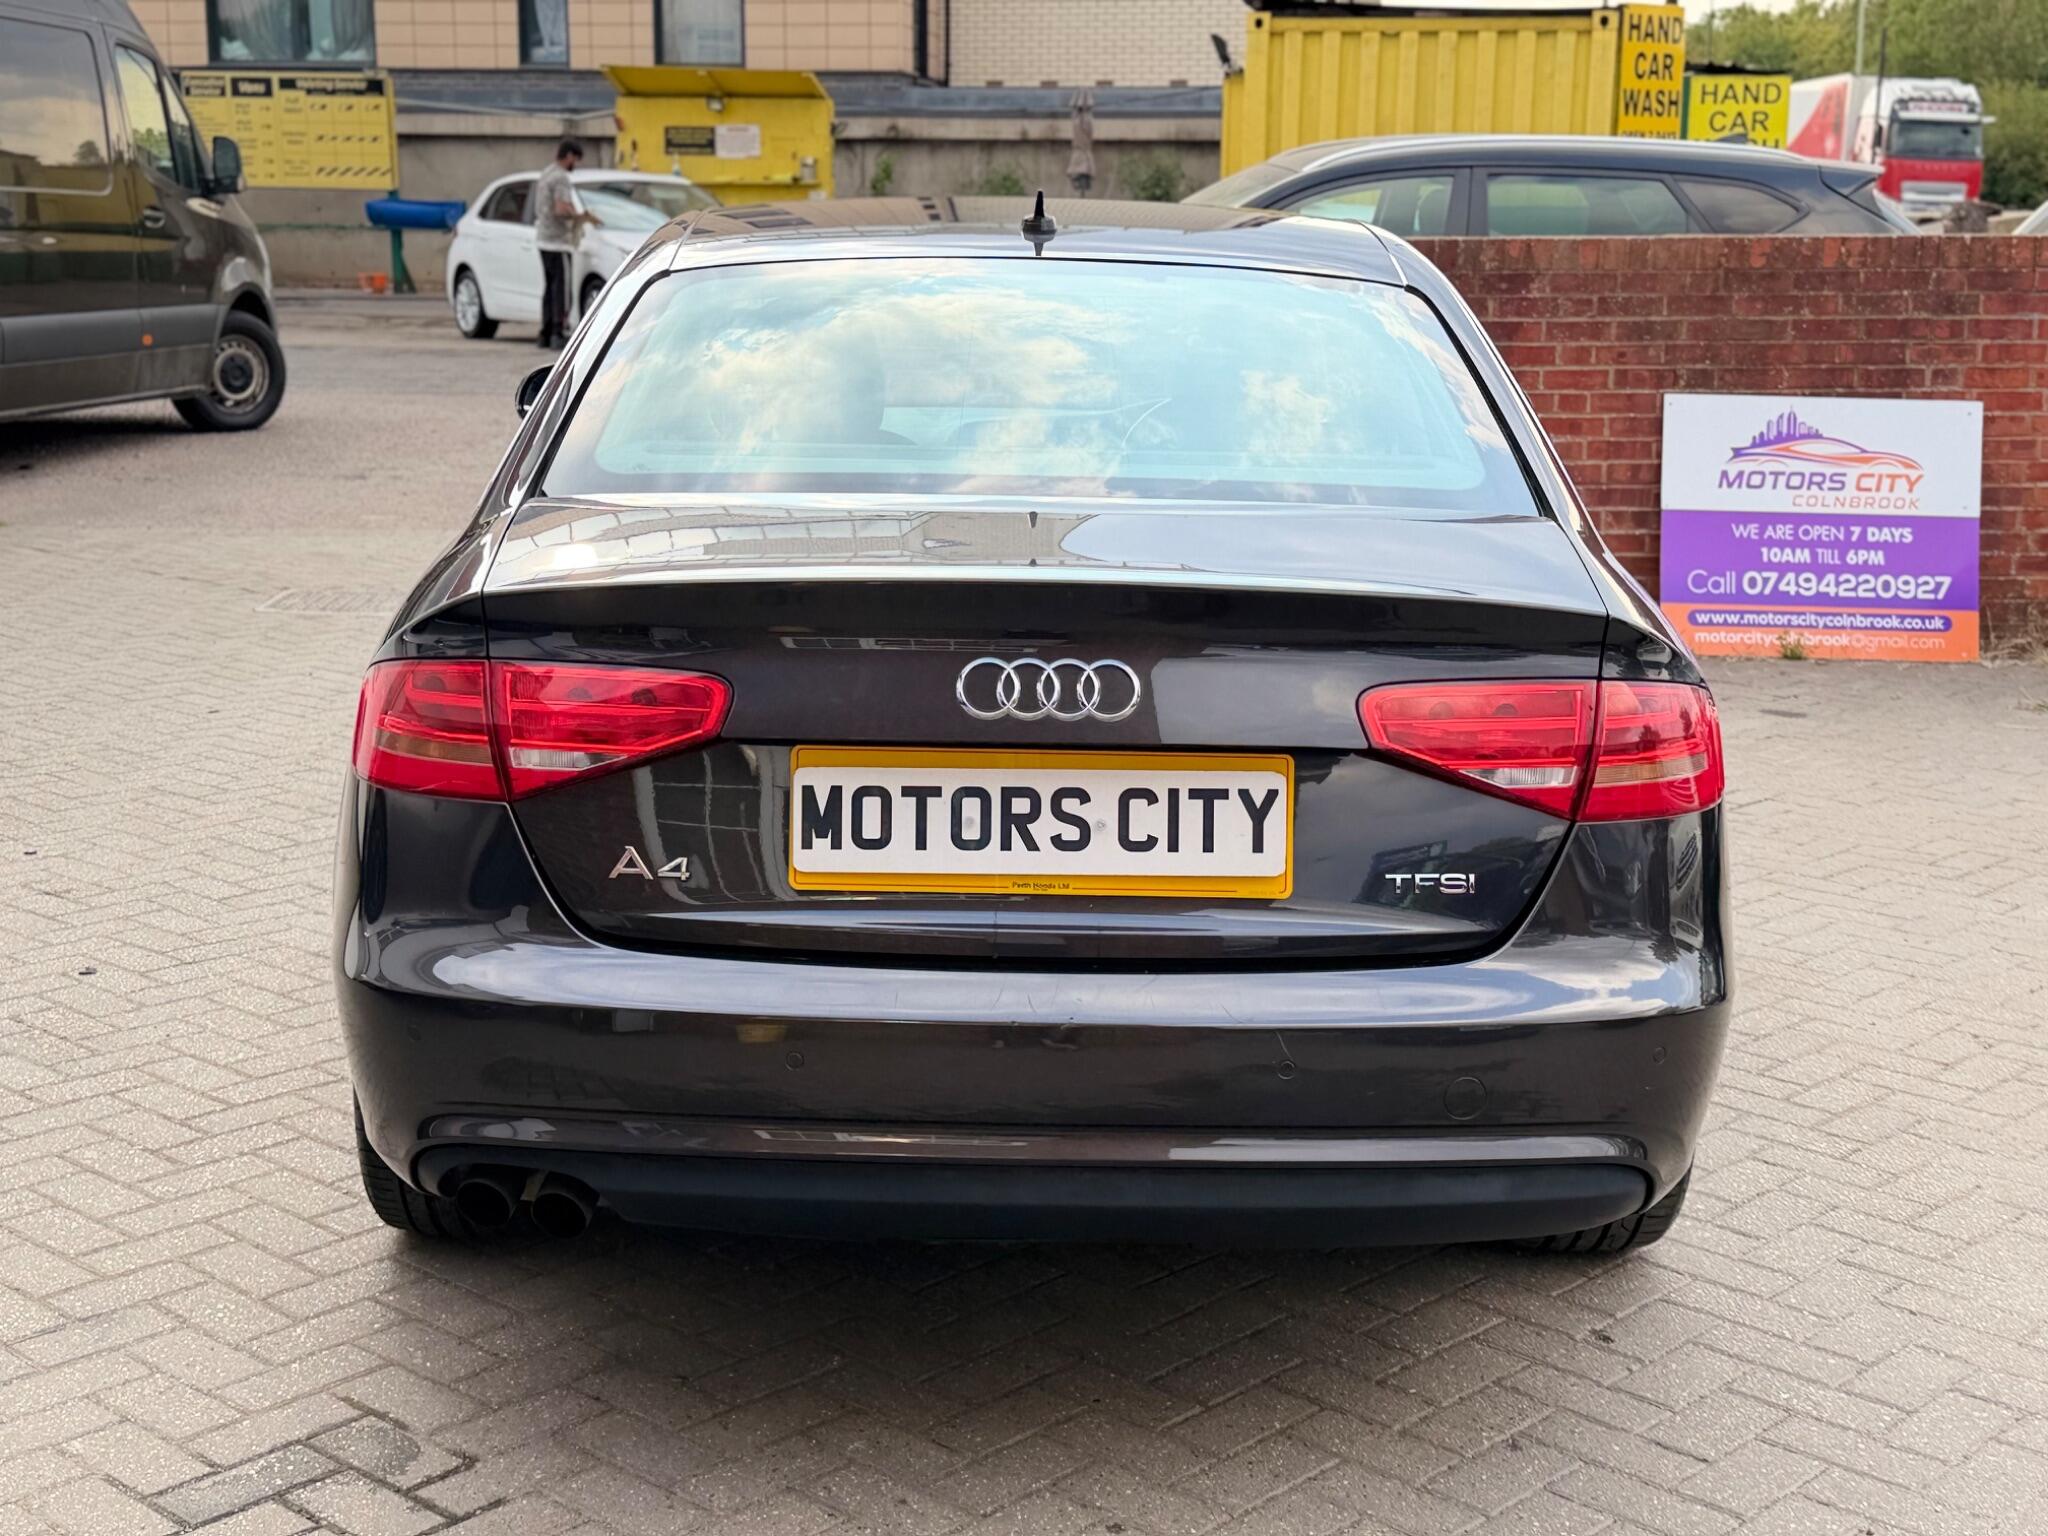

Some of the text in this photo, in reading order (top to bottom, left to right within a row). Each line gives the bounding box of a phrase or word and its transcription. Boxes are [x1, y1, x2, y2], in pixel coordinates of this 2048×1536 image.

[1628, 14, 1683, 44] HAND
[1634, 52, 1674, 81] CAR
[1623, 88, 1680, 118] WASH
[1700, 83, 1782, 105] HAND
[1709, 110, 1770, 132] CAR
[1718, 470, 1924, 493] MOTORS CITY
[1792, 495, 1920, 510] COLNBROOK
[1731, 523, 1913, 543] WE ARE OPEN 7 DAYS
[1761, 547, 1885, 565] 10AM TILL 6PM
[1687, 570, 1952, 600] Call 07494220927
[1695, 612, 1945, 631] www.motorscitycolnbrook.co.uk
[800, 785, 1280, 854] MOTORS CITY
[608, 845, 691, 881] A4
[1385, 873, 1475, 894] TFSI
